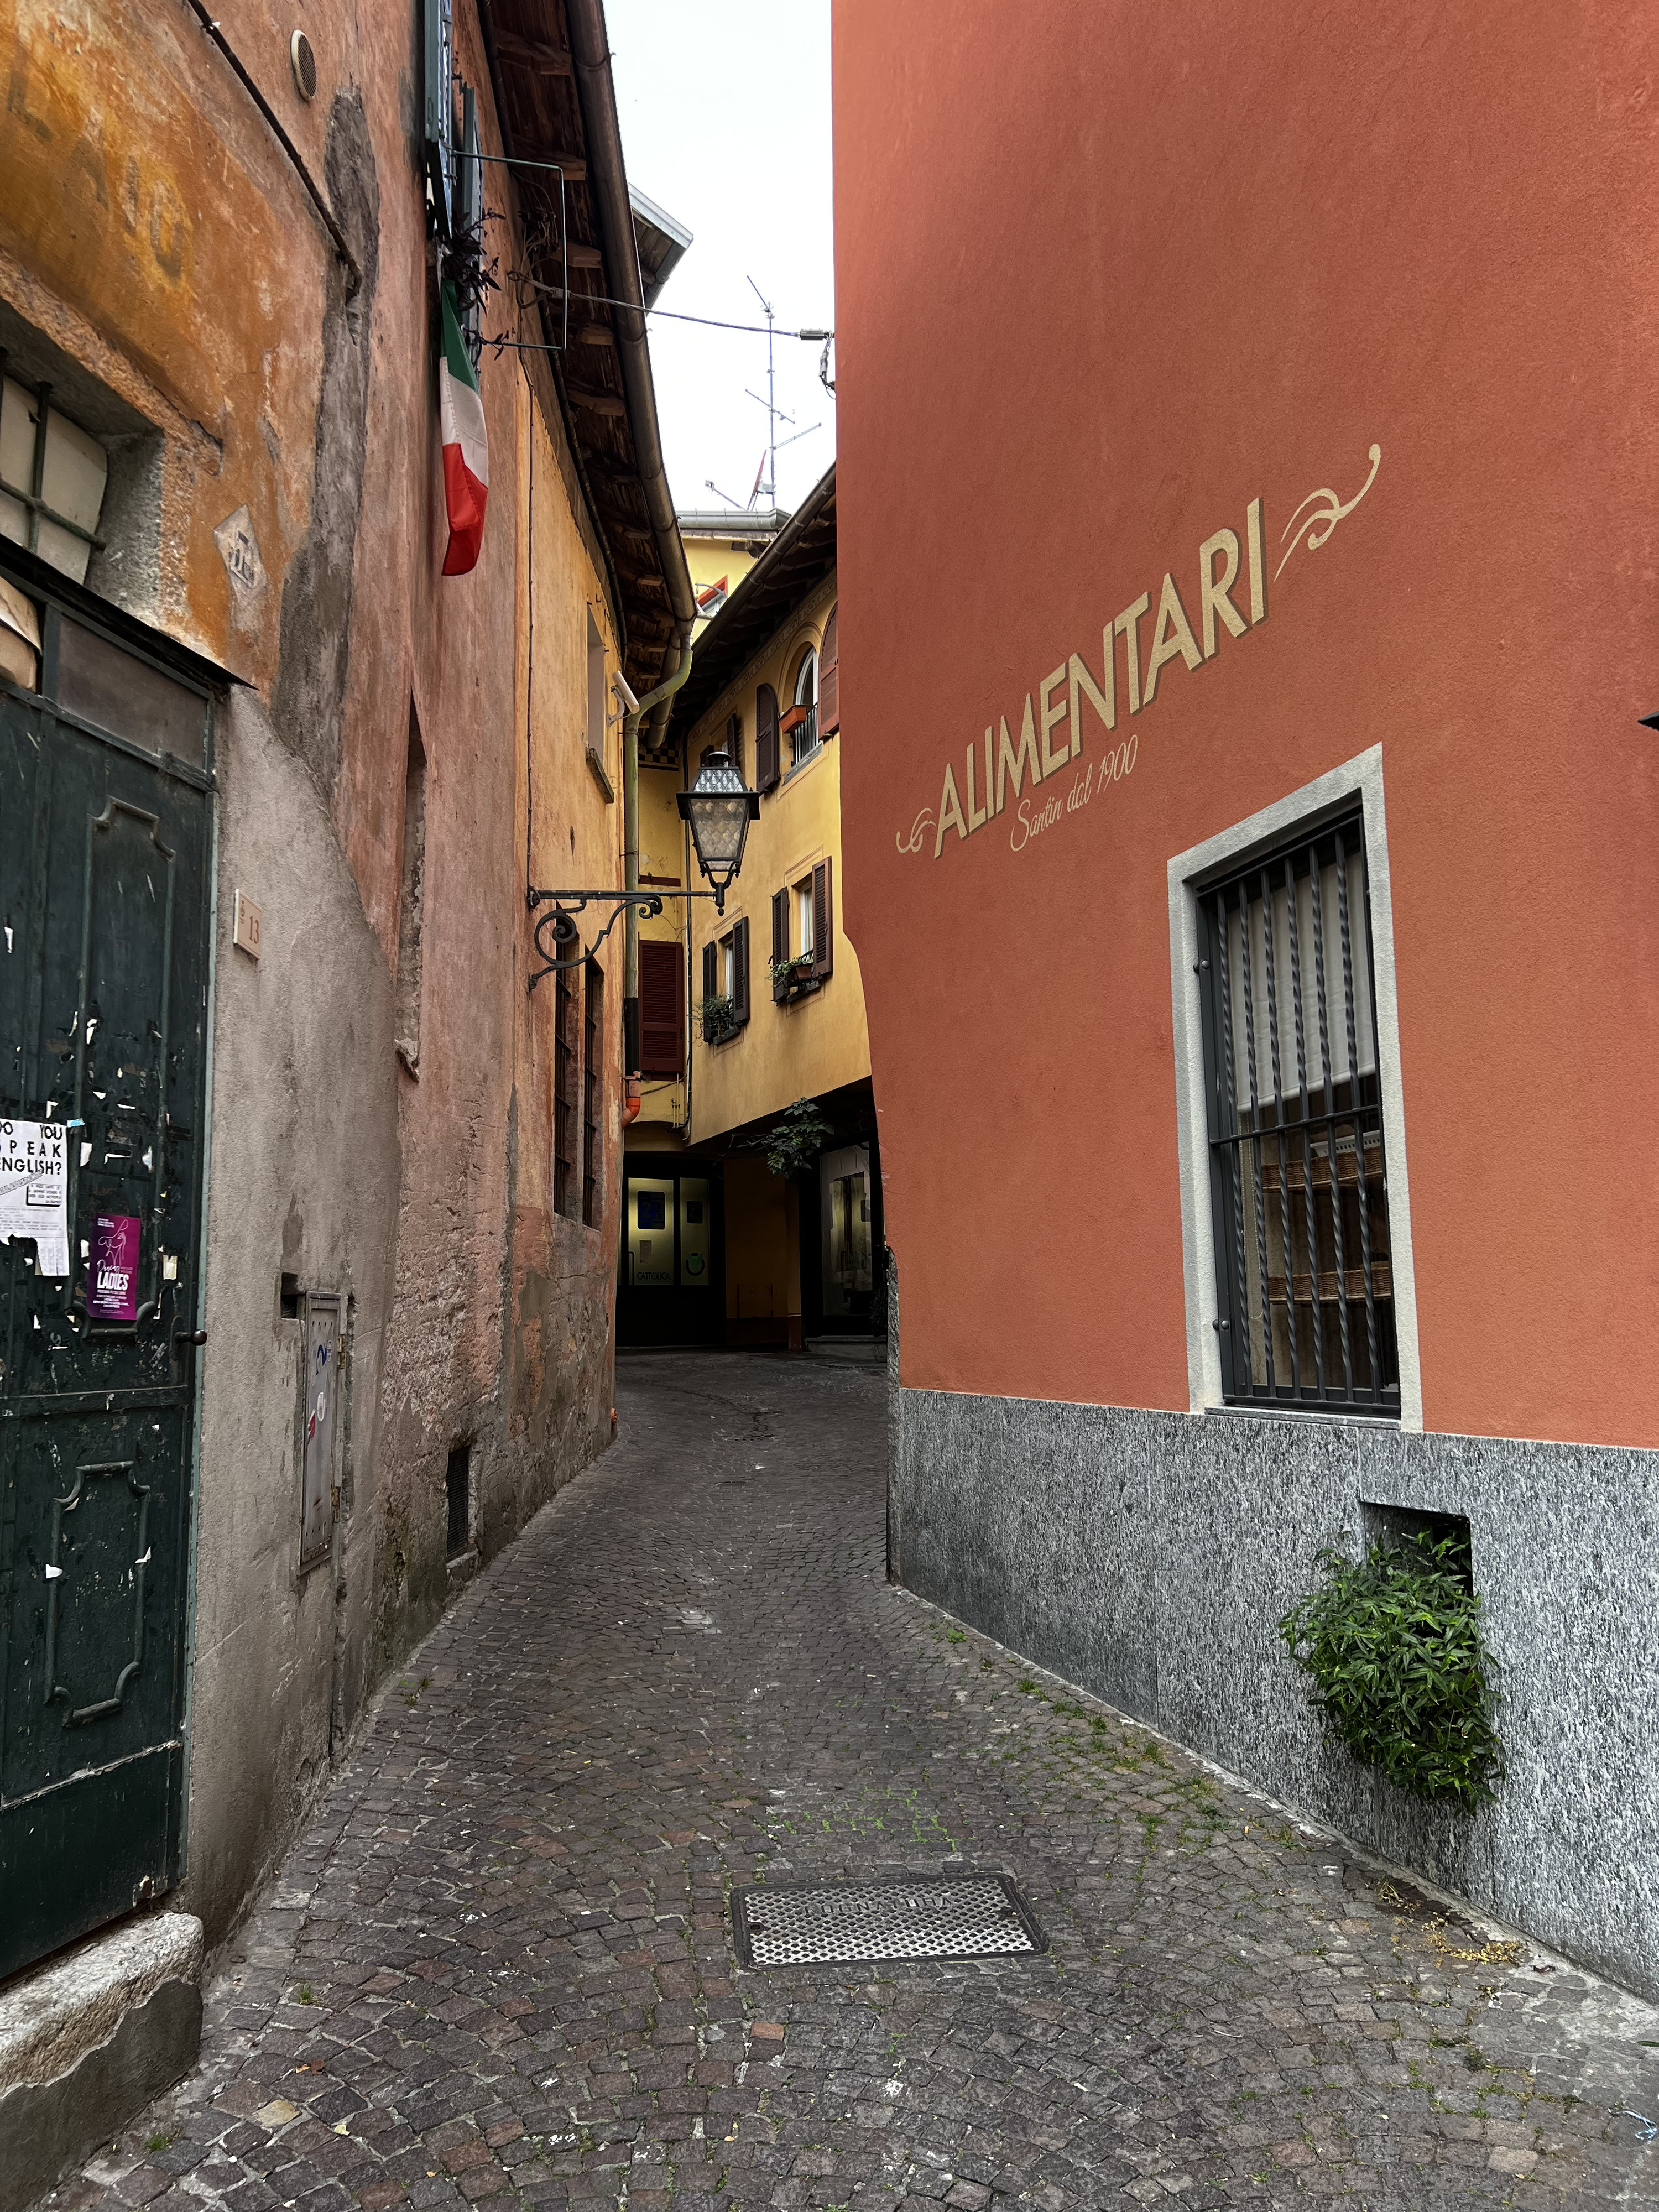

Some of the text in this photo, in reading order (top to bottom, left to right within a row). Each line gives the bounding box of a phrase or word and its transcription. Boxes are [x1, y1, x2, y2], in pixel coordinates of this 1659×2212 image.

[934, 498, 1266, 858] ALIMENTARI
[1010, 734, 1138, 852] Santin dal 1900
[249, 916, 260, 944] 13
[0, 1121, 62, 1140] O YOU
[0, 1140, 61, 1157] PEAK
[0, 1157, 61, 1175] NGLISH?
[97, 1272, 129, 1291] LADIES
[637, 1272, 671, 1280] CATTOLICA
